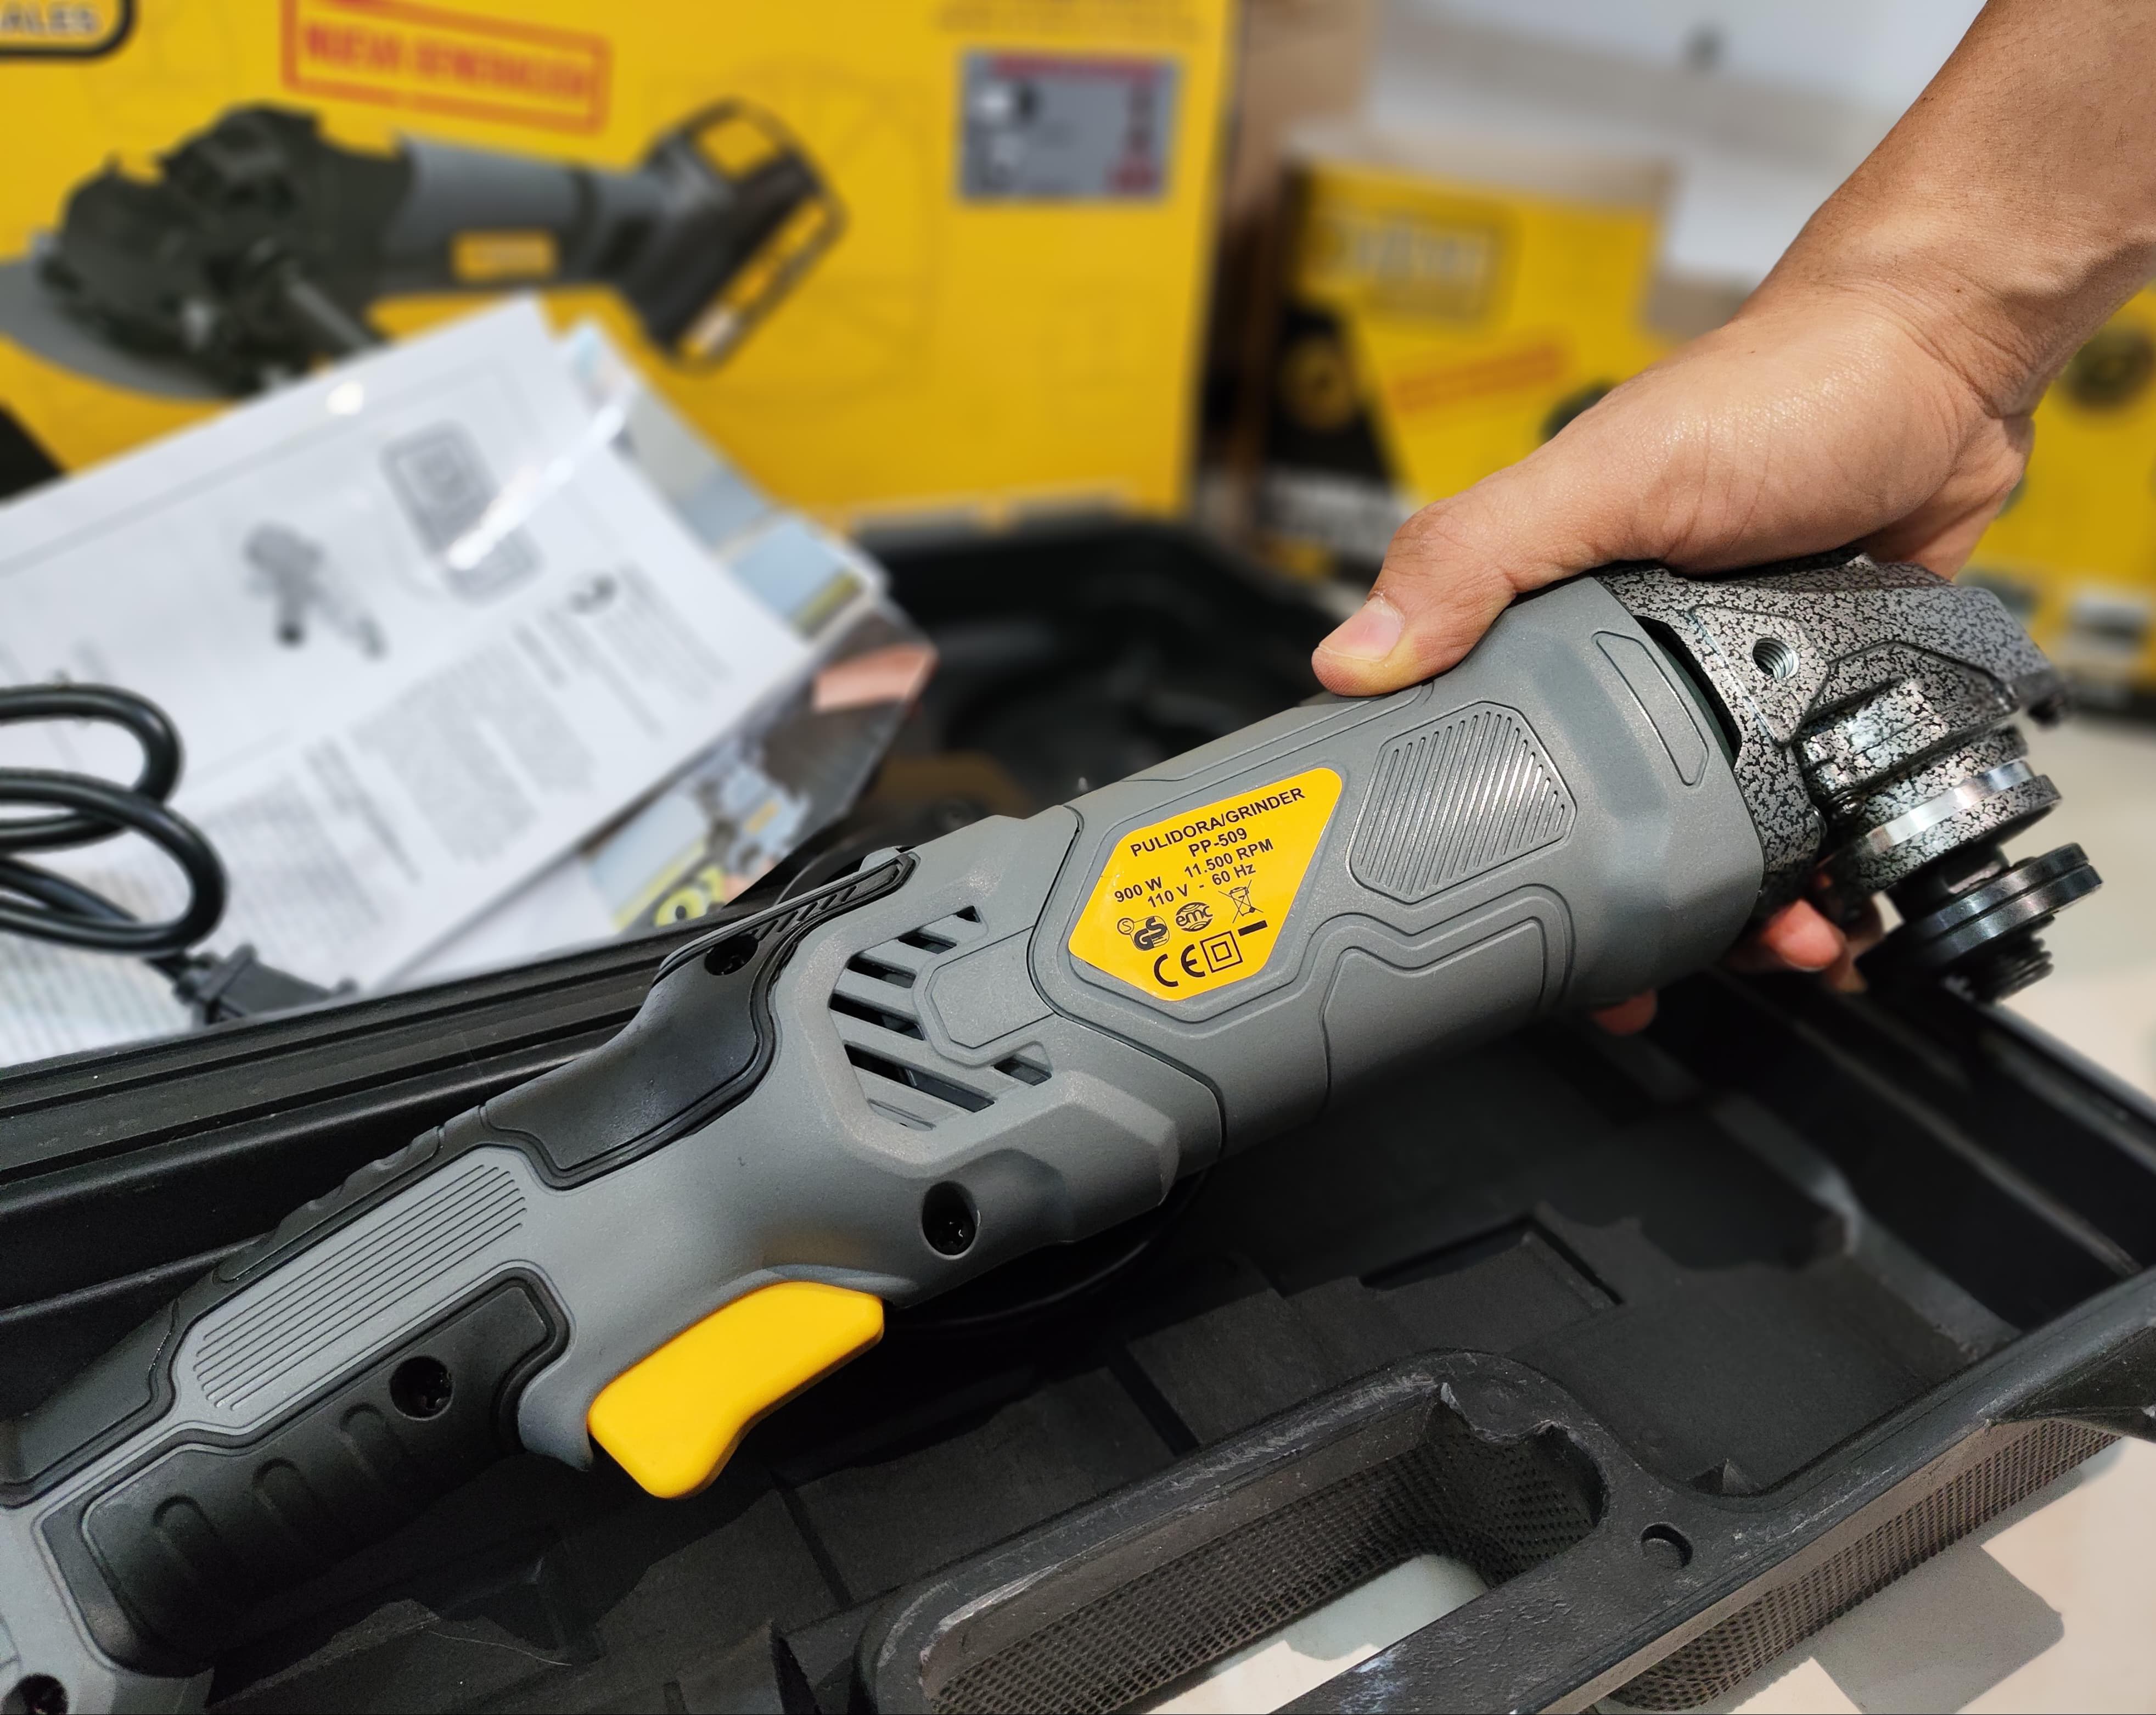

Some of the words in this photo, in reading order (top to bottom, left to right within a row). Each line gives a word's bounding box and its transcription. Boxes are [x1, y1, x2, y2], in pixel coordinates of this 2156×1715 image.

[1130, 787, 1306, 857] PULIDORA/GRINDER
[1188, 827, 1248, 857] PP-509
[1114, 884, 1143, 903] 900
[1145, 876, 1163, 892] W
[1184, 852, 1233, 878] 11.500
[1236, 838, 1274, 861] RPM
[1147, 889, 1175, 908] 110
[1176, 883, 1188, 897] V
[1212, 870, 1231, 885] 60
[1233, 863, 1256, 879] Hz
[1153, 944, 1206, 988] CE
